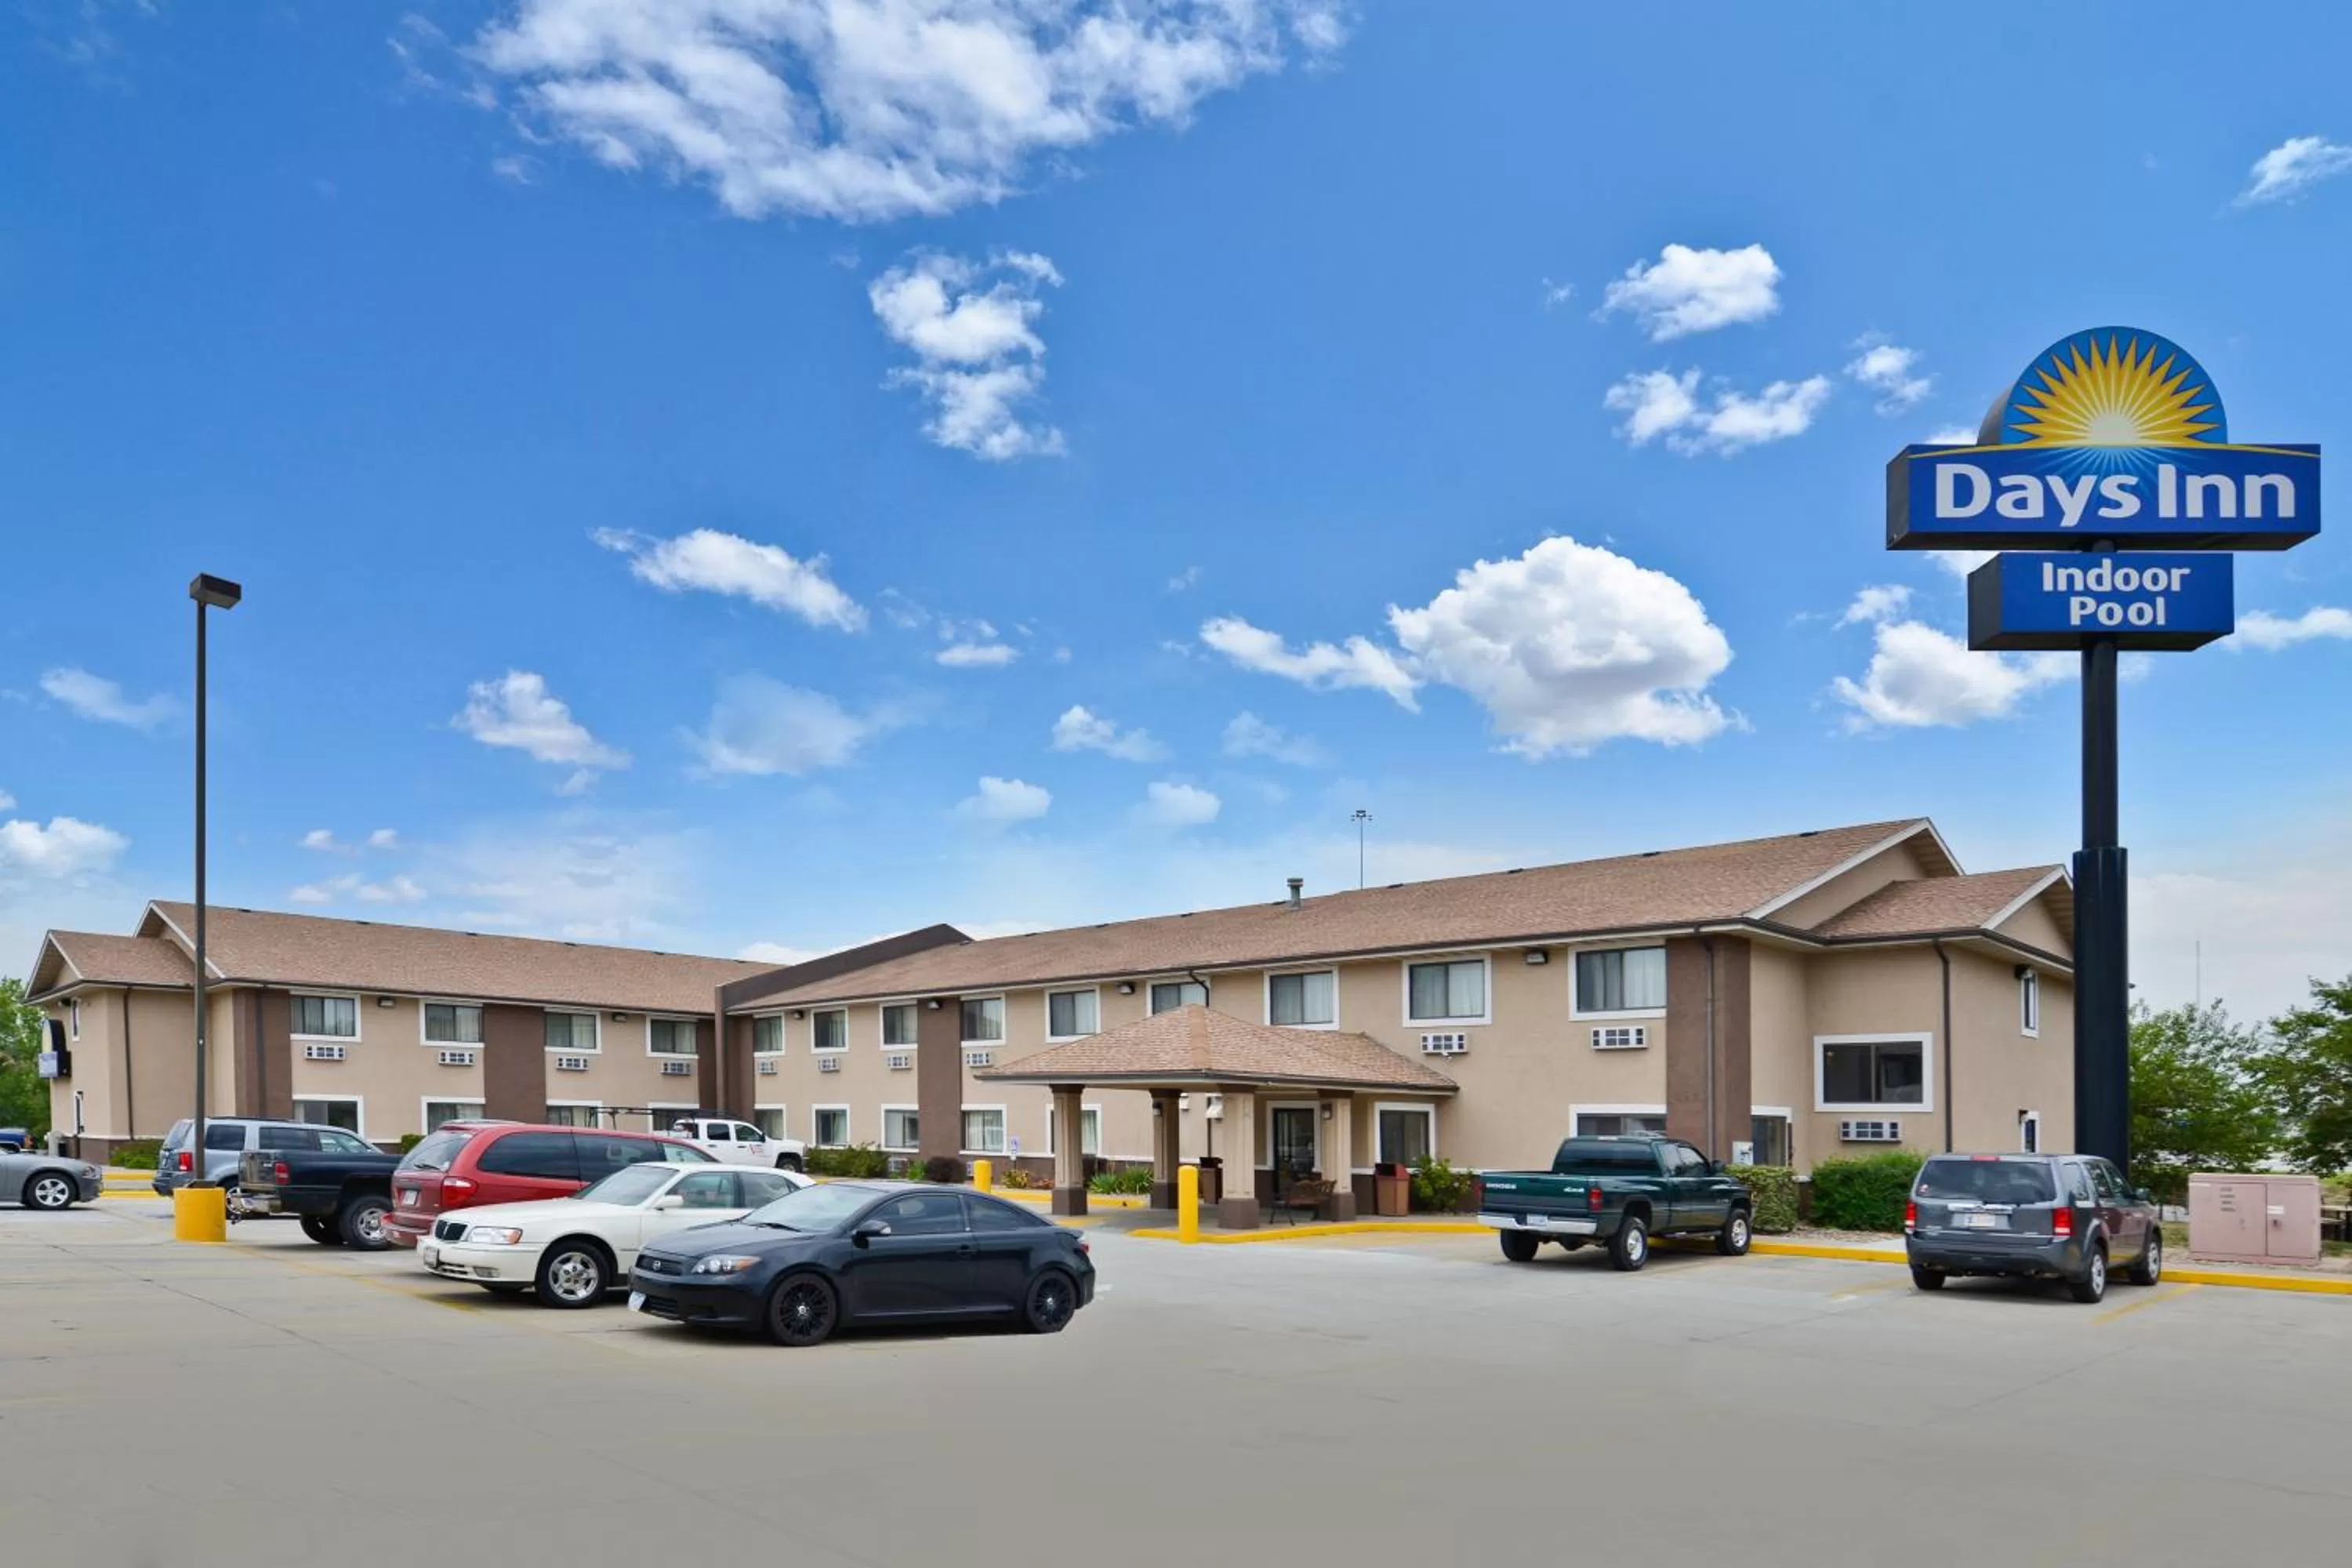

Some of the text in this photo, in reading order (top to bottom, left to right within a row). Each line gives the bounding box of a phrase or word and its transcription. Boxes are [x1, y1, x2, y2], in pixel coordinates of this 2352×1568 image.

[1935, 463, 2296, 528] Days Inn
[2042, 558, 2191, 593] Indoor
[2069, 596, 2165, 626] Pool
